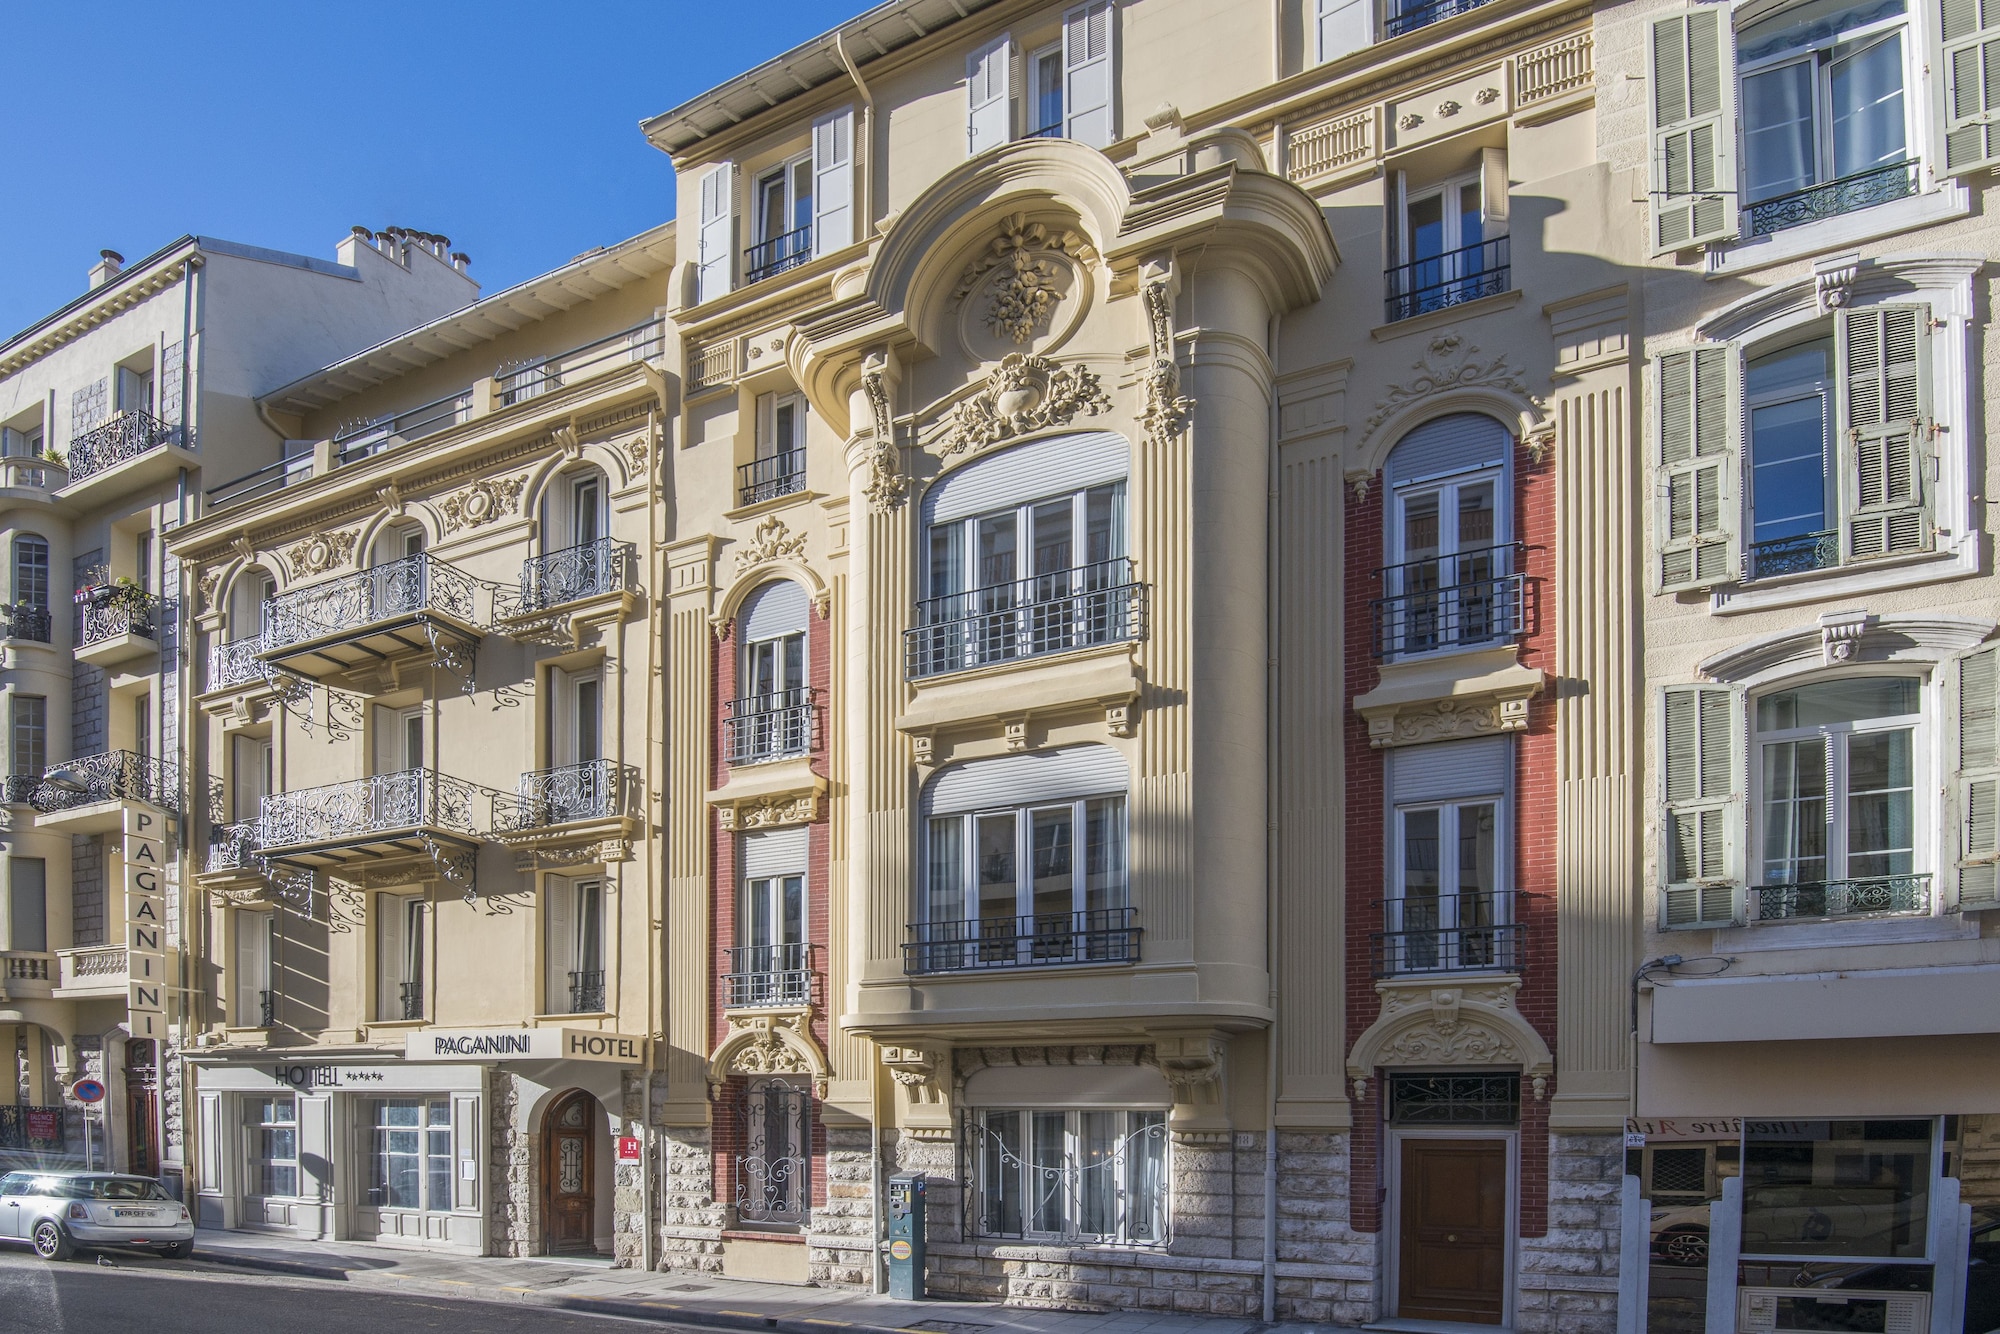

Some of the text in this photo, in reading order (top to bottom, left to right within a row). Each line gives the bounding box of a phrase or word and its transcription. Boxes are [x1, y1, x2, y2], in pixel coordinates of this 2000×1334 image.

[136, 813, 157, 1034] PAGANINI
[435, 1034, 530, 1055] PAGANINI
[571, 1034, 638, 1058] HOTEL
[275, 1065, 341, 1086] HOTEL
[627, 1141, 637, 1151] H
[917, 1181, 924, 1191] P
